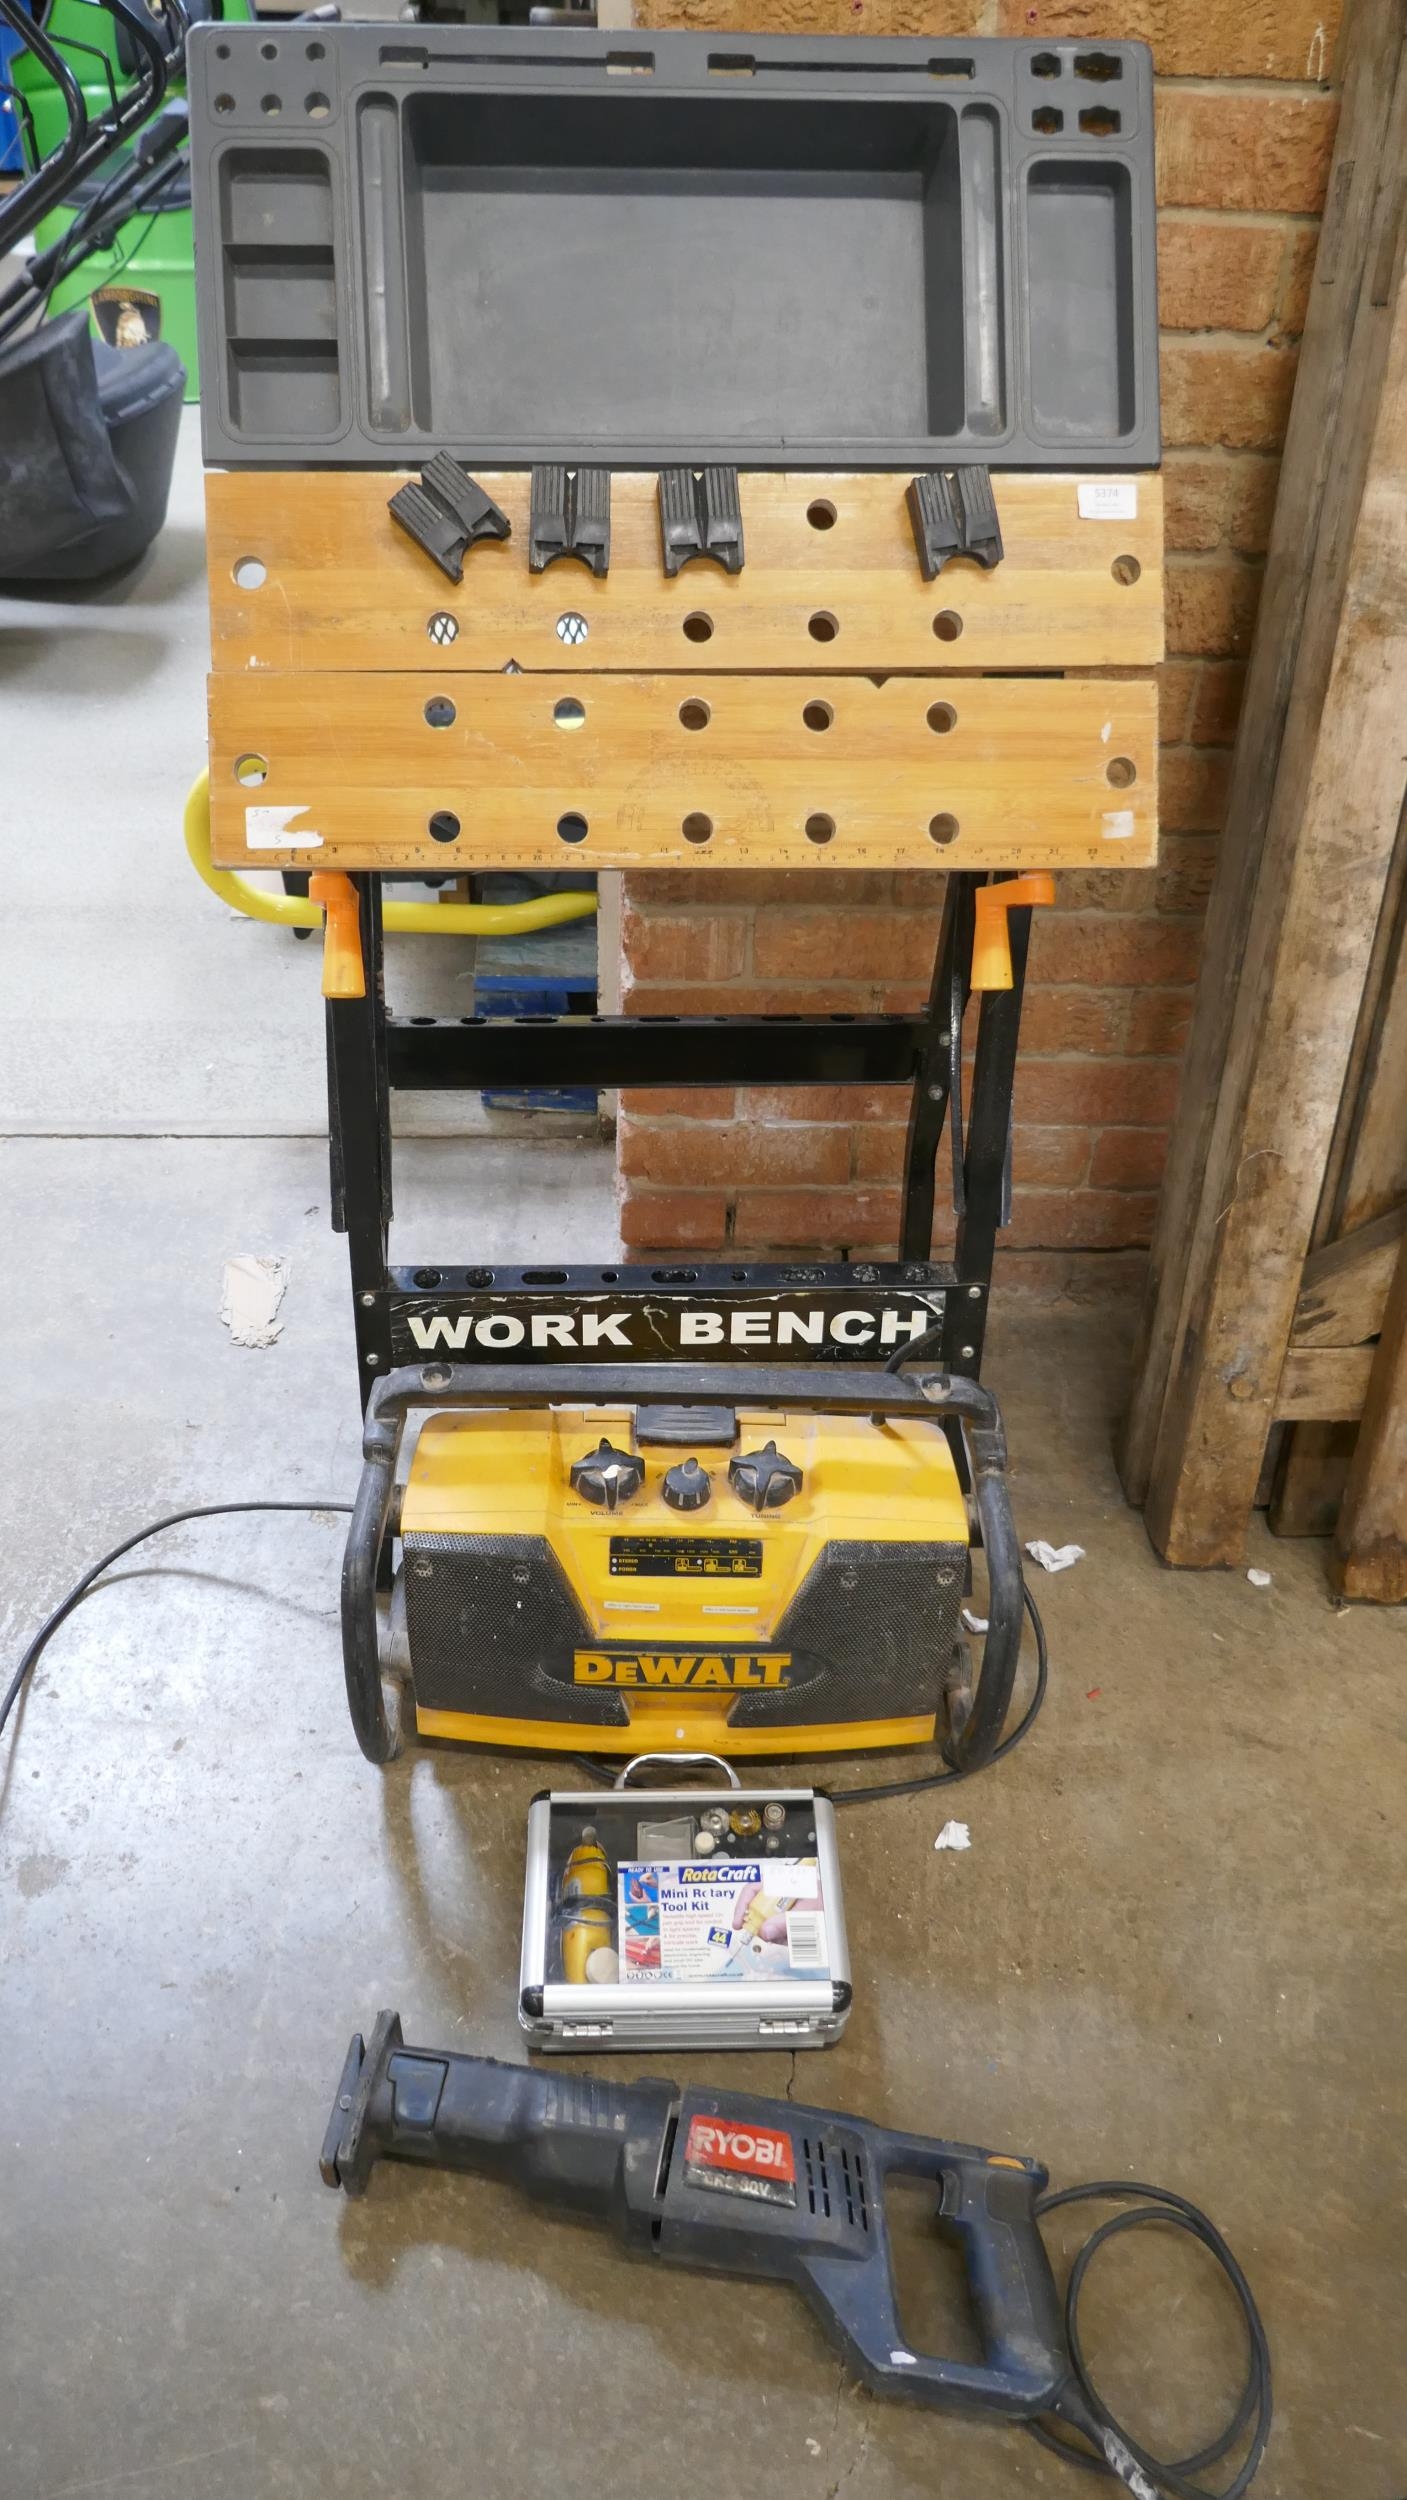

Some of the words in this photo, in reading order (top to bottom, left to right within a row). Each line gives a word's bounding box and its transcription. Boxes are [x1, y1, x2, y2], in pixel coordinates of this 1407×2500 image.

[407, 1313, 633, 1349] WORK
[679, 1310, 927, 1345] BENCH
[682, 1866, 758, 1882] RotaCraft
[661, 1888, 688, 1899] Mini
[662, 1902, 687, 1912] Tool
[691, 1901, 710, 1911] Kit
[693, 2125, 784, 2167] RYOBI
